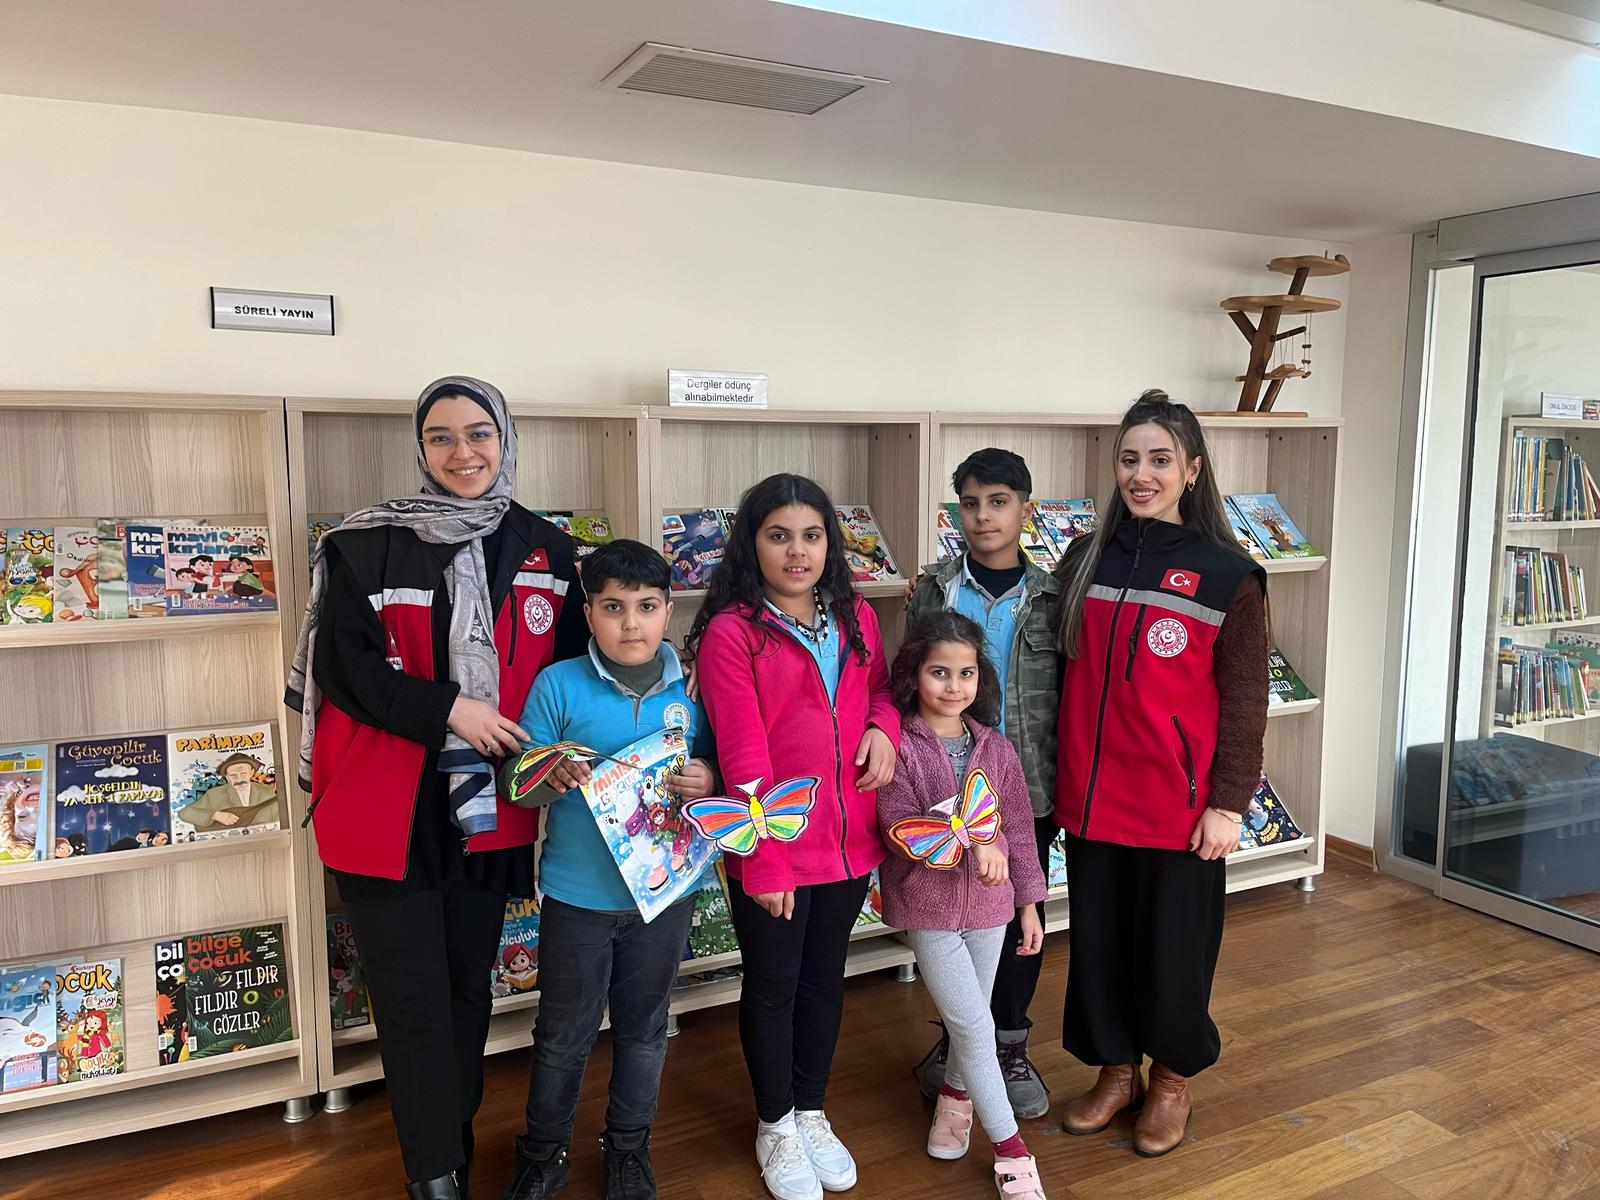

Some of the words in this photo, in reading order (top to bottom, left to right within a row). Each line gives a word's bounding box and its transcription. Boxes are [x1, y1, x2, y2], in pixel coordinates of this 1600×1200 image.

[234, 304, 277, 316] SÜRELİ
[280, 308, 314, 319] YAYIN
[687, 378, 722, 391] Dergiler
[724, 380, 752, 392] ödünç
[684, 392, 754, 403] alınabilmektedir
[168, 531, 218, 542] mavi
[68, 739, 147, 760] Güvenilir
[176, 732, 265, 752] PARİMPAR
[187, 935, 242, 954] bilge
[187, 948, 253, 973] çocuk
[235, 964, 279, 990] FILDIR
[195, 990, 239, 1015] FILDIR
[213, 1011, 260, 1036] GÖZLER
